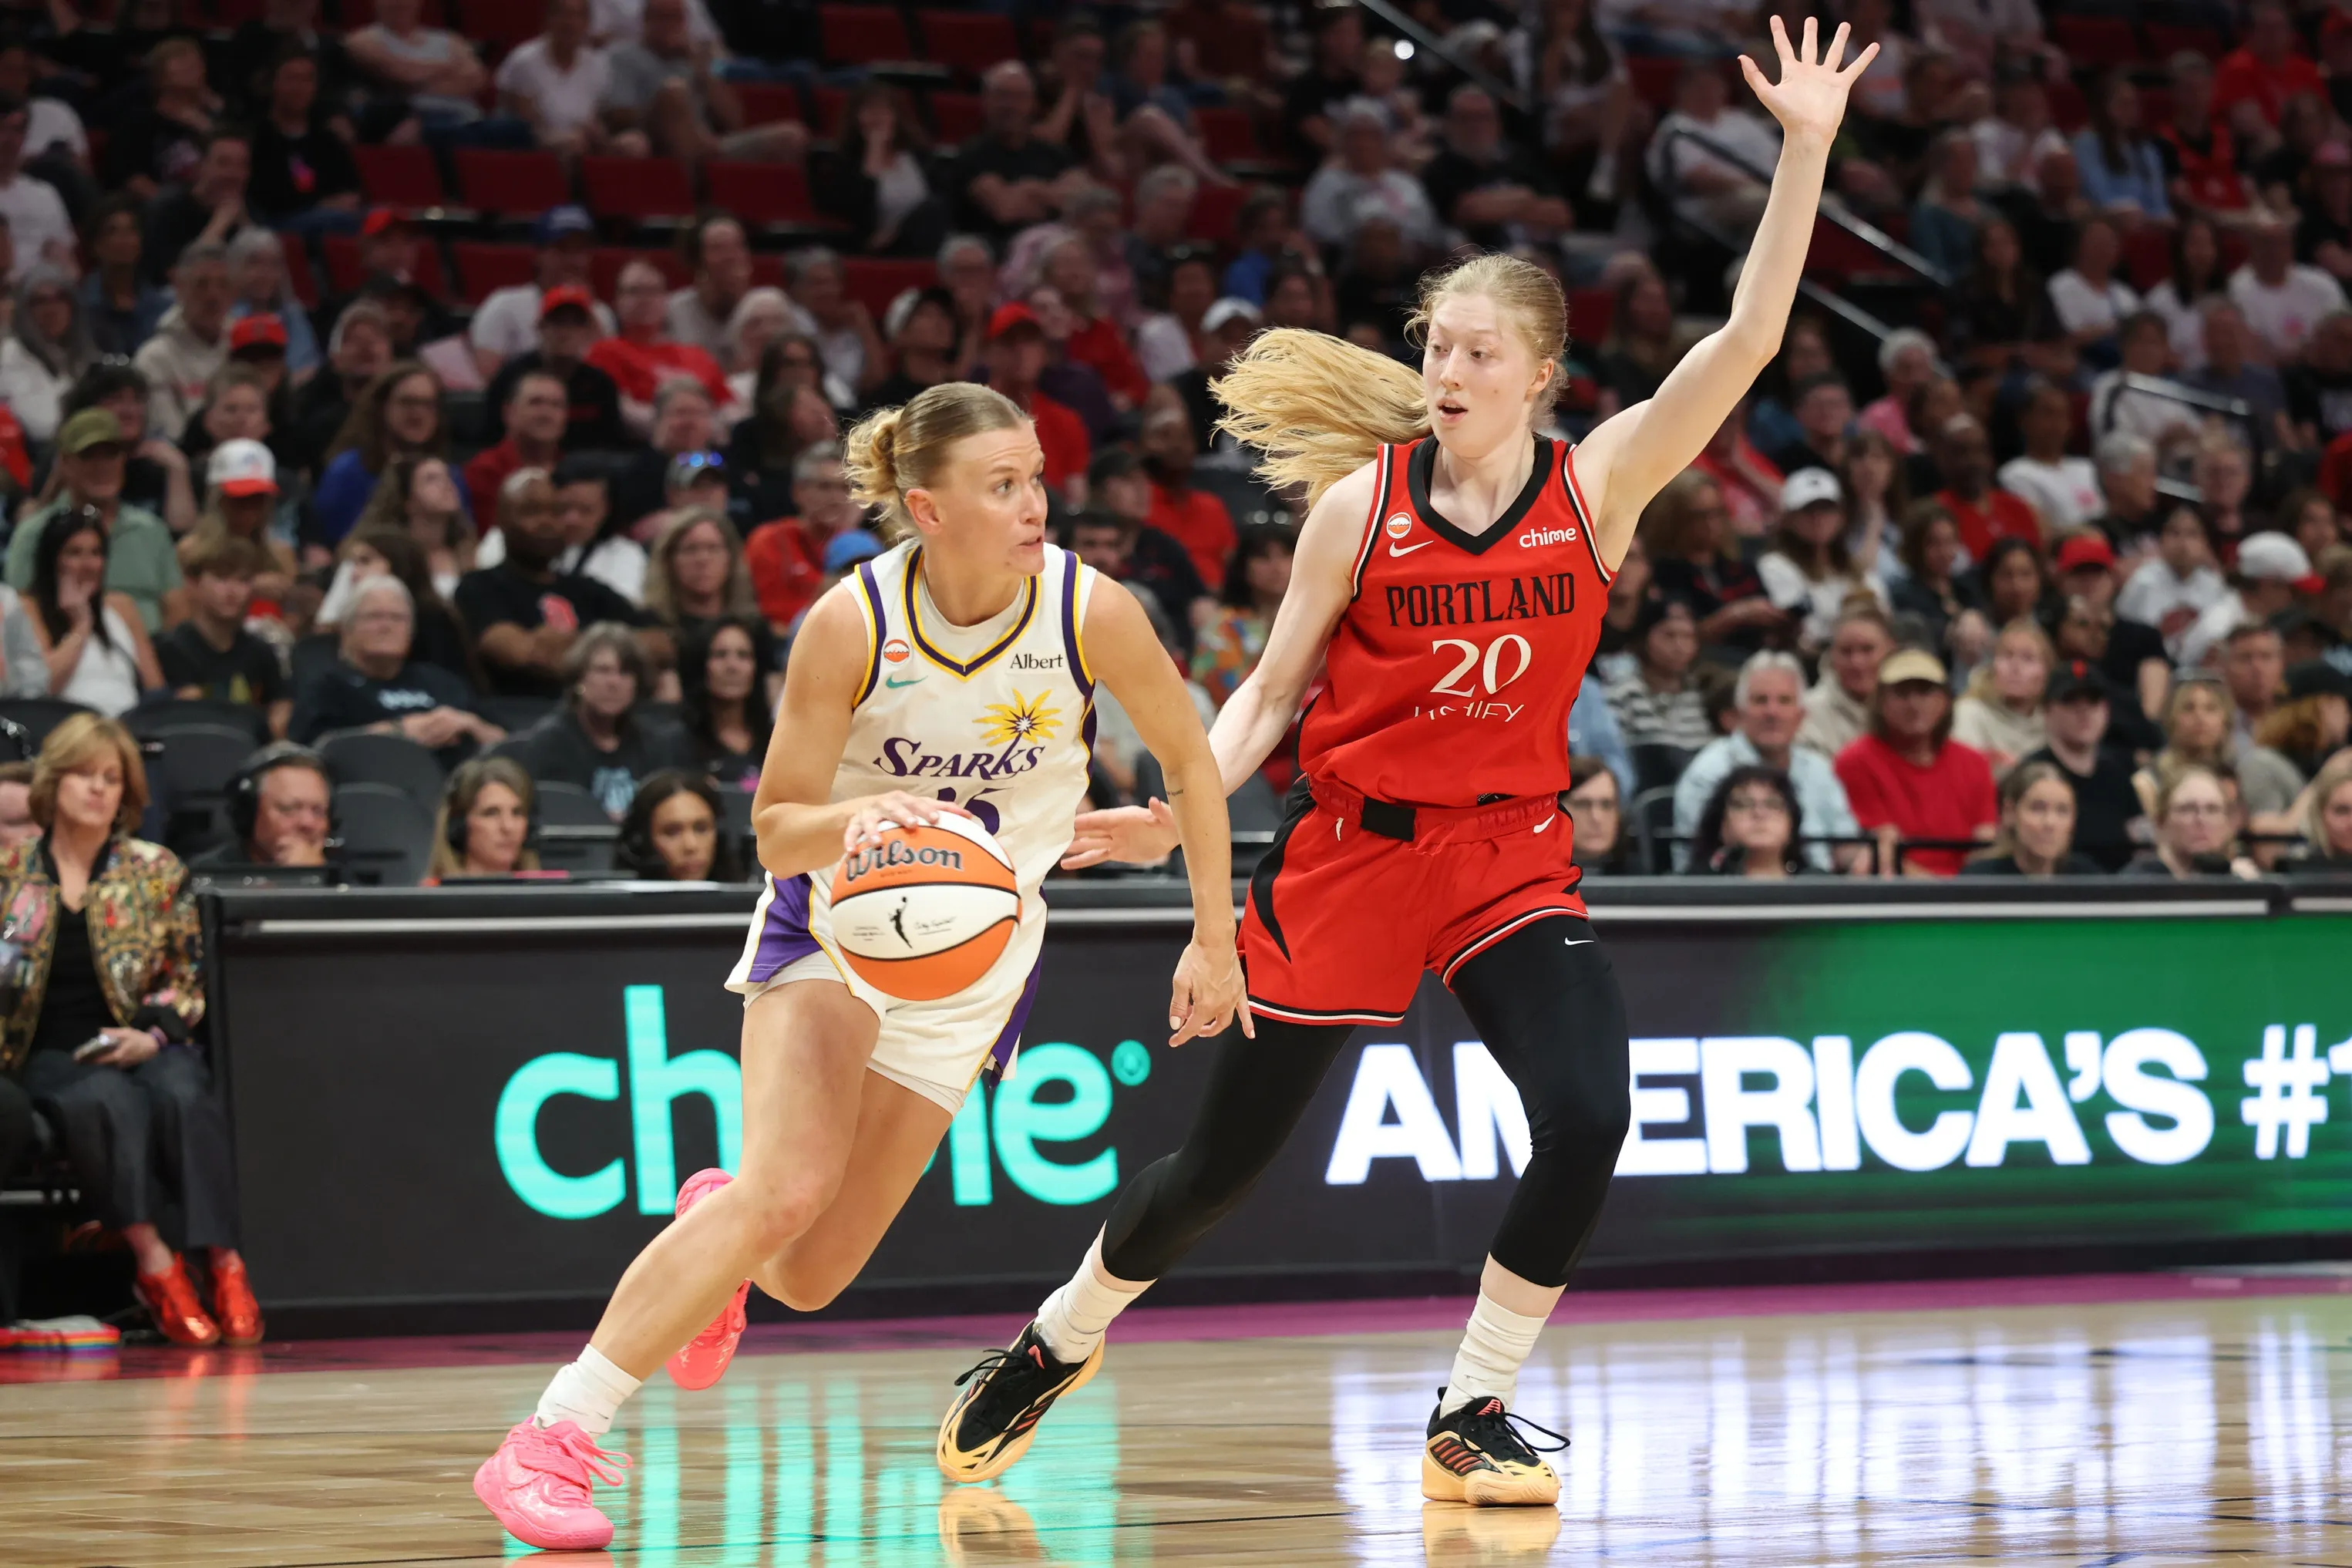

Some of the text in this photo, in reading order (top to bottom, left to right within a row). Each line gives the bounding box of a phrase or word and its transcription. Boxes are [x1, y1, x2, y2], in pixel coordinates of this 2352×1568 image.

[1519, 527, 1577, 549] chime
[1385, 572, 1575, 627] PORTLAND
[1010, 653, 1064, 669] Albert
[1429, 634, 1532, 698] 20
[873, 732, 1045, 780] SPARKS
[846, 839, 964, 883] Wilson
[494, 984, 1119, 1220] che
